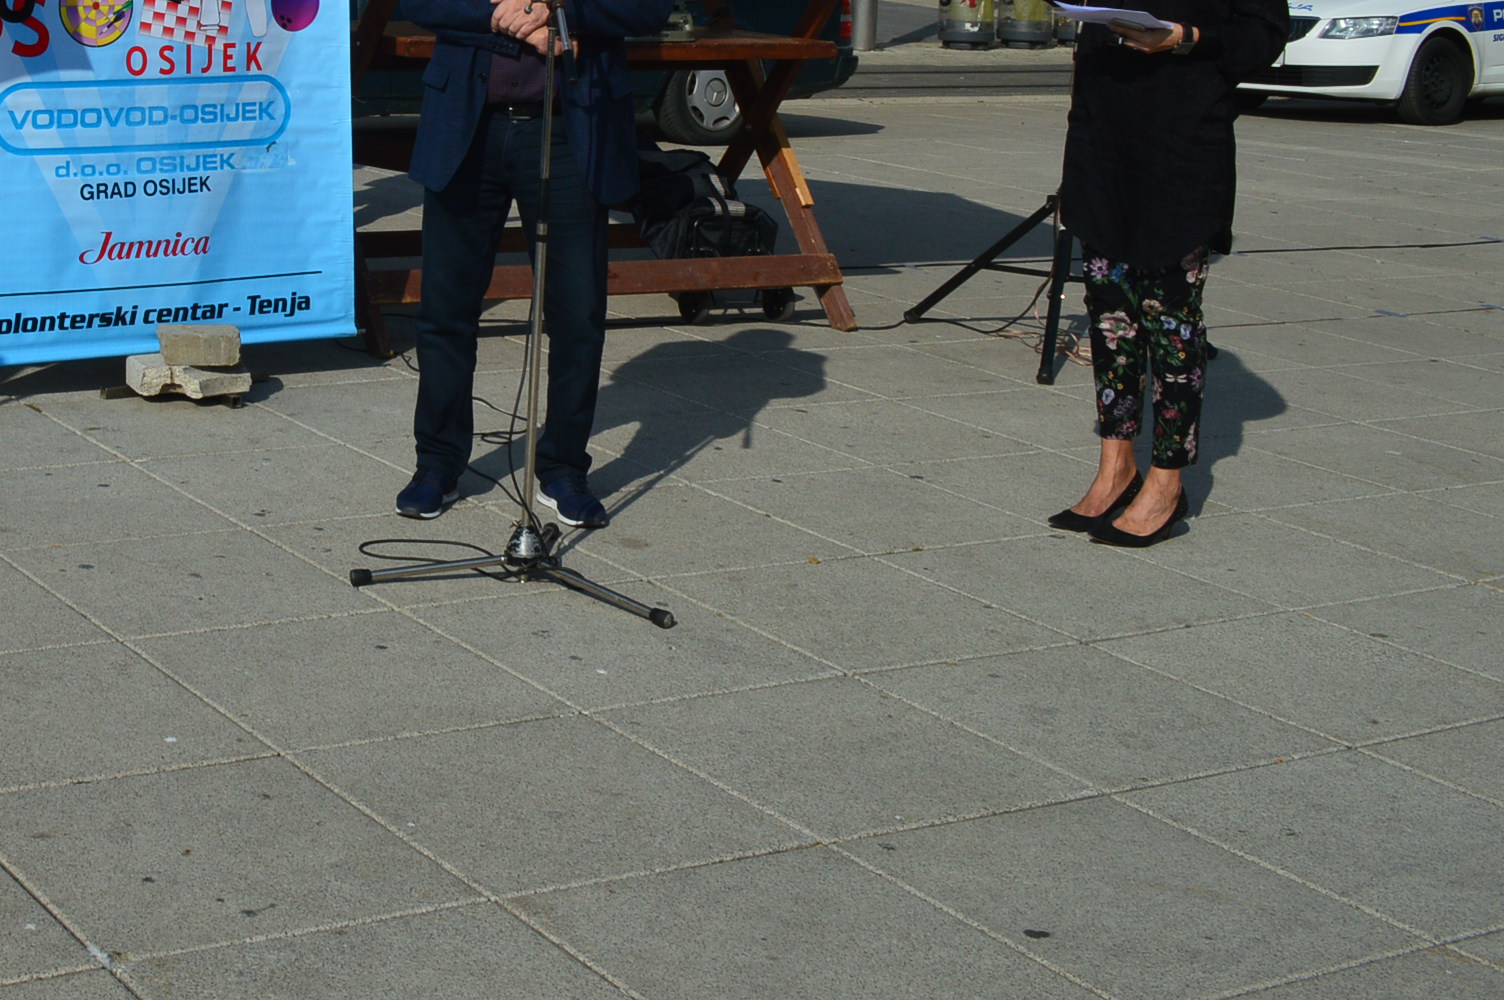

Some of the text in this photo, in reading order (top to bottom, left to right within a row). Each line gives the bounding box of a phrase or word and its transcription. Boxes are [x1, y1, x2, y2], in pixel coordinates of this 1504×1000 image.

[125, 41, 263, 76] OSIJEK
[8, 100, 276, 130] VODOVOD-OSIJEK
[55, 153, 236, 178] d.o.o. OSIJEK
[79, 175, 212, 201] GRAD OSIJEK
[78, 231, 211, 265] Jamnica
[142, 302, 228, 325] centar
[246, 291, 311, 319] Tenja
